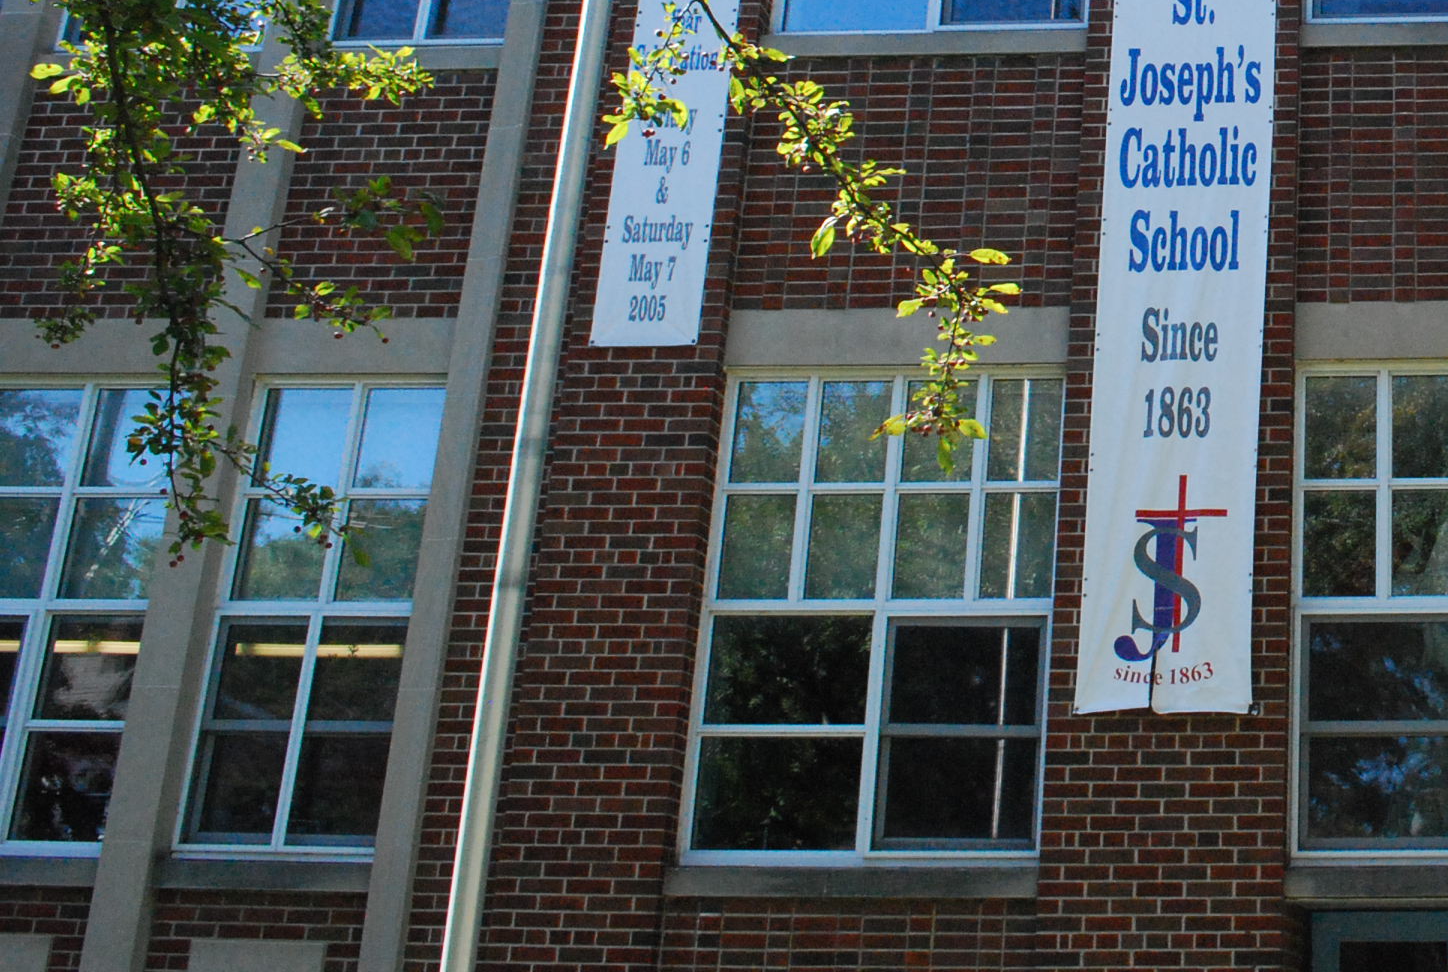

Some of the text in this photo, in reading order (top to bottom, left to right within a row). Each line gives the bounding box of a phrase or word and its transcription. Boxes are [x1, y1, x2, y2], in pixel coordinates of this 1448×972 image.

[1119, 44, 1262, 122] Joseph's
[643, 139, 691, 174] May 6
[1119, 125, 1257, 189] Catholic
[655, 176, 669, 204] &
[622, 214, 694, 250] Saturday
[1128, 209, 1240, 273] School
[628, 254, 677, 290] May 7
[628, 295, 667, 322] 2005
[1141, 306, 1219, 364] Since
[1143, 385, 1211, 439] 1863
[1113, 662, 1214, 685] since 1863
